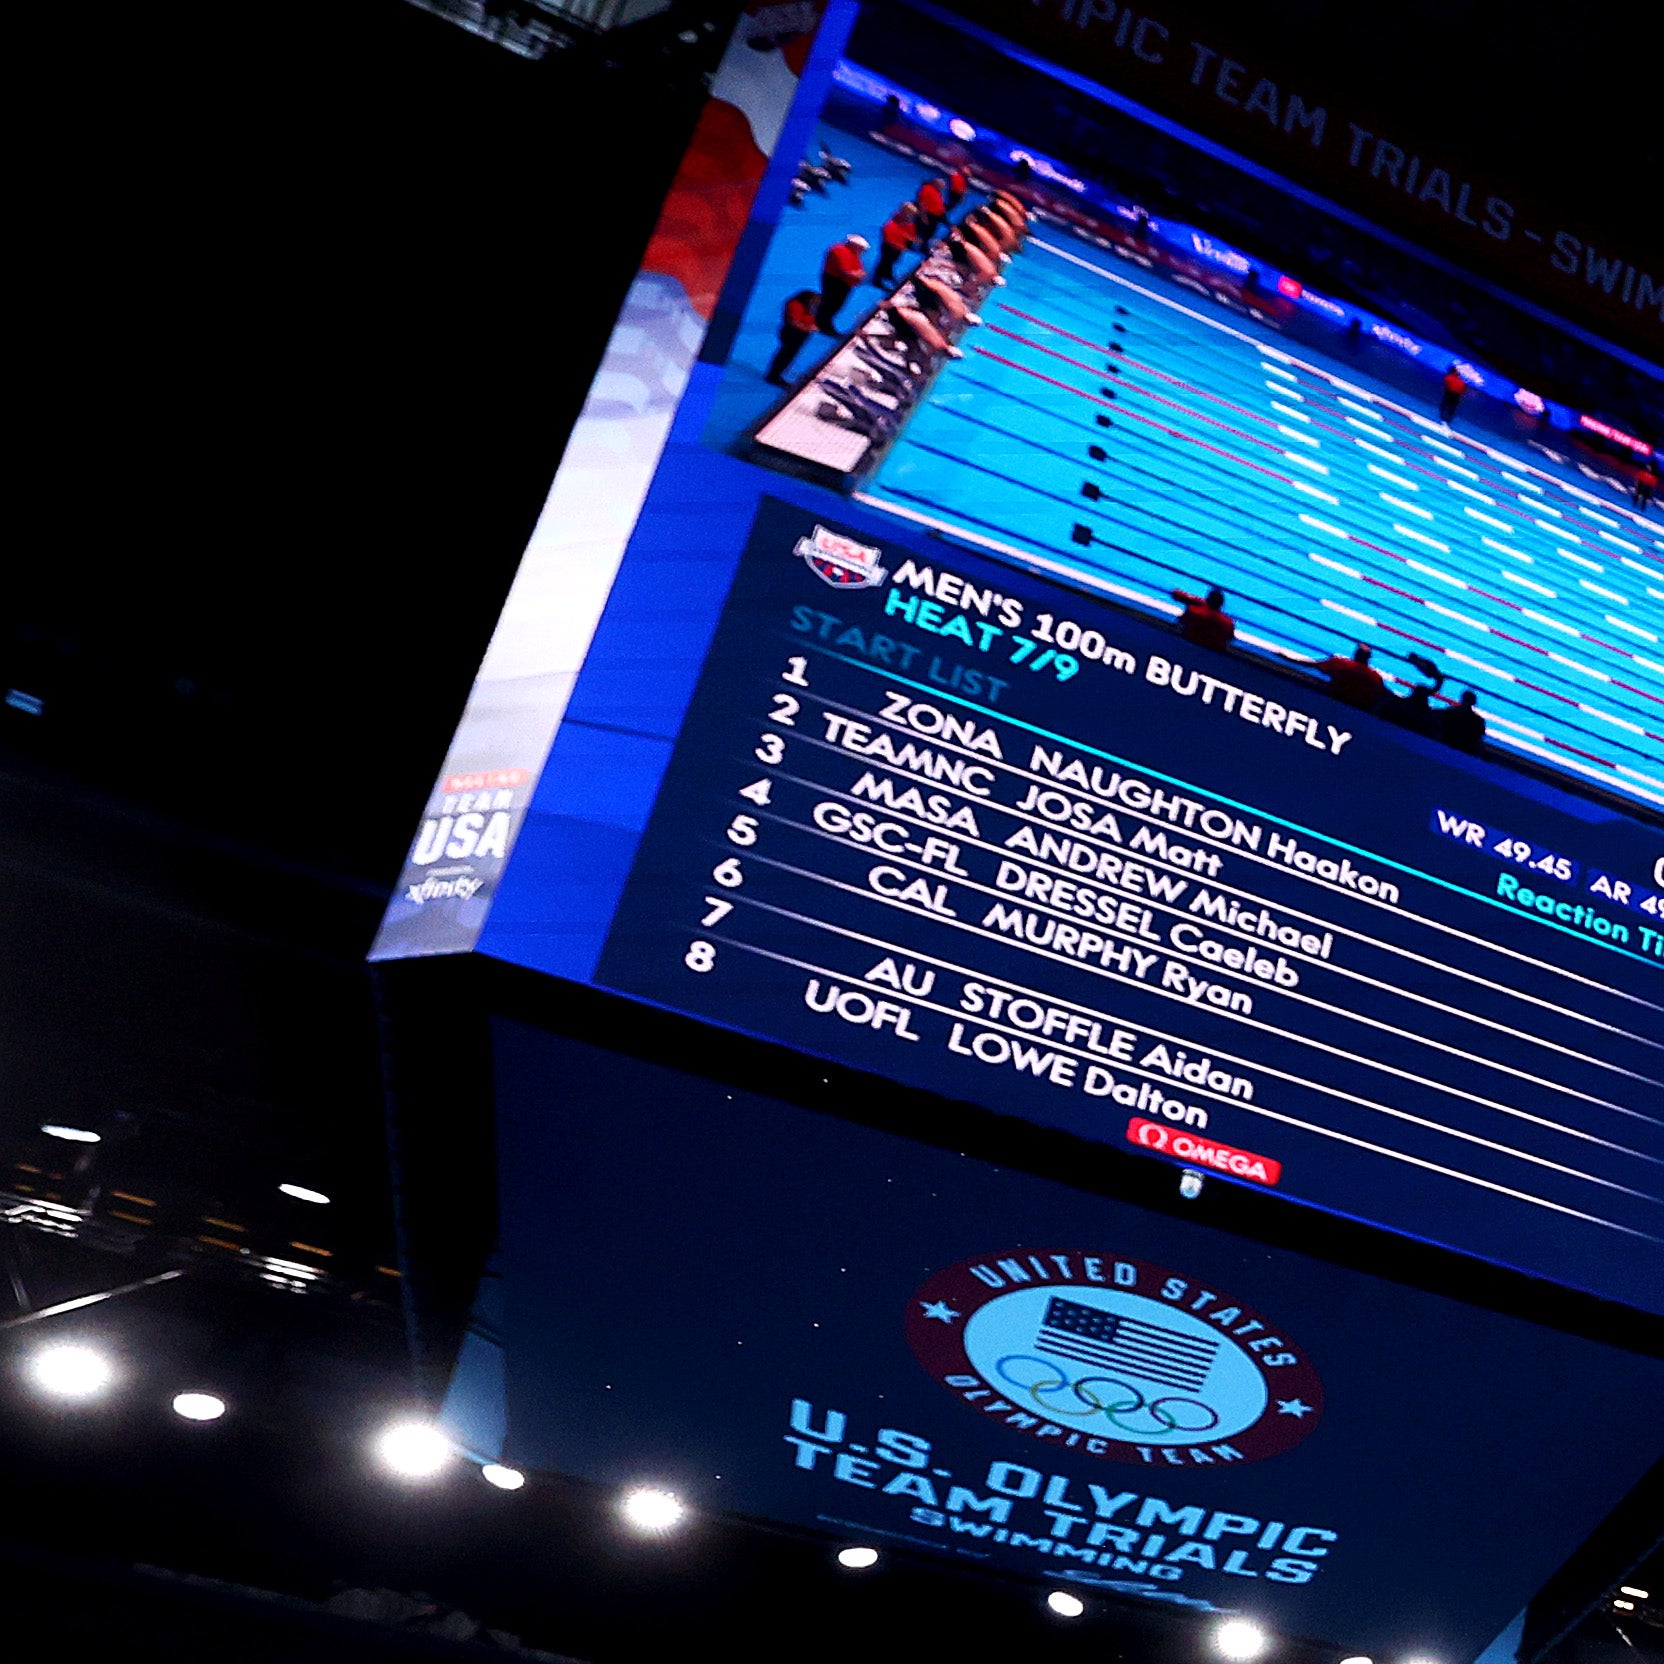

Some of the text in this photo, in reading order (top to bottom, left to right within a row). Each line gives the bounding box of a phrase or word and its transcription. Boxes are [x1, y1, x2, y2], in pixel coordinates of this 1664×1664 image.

[1189, 41, 1330, 149] TEAM
[789, 605, 1010, 704] START LIST
[884, 587, 1080, 684] HEAT 7/9
[891, 559, 1352, 756] MEN'S 100m BUTTERFLY
[768, 694, 1224, 879] 2 TEAMNC JOSA Matt
[781, 655, 1401, 904] 1 ZONA NAUGHTON Haakon
[411, 811, 512, 866] USA
[712, 856, 744, 889] 6
[739, 777, 1301, 988] 4 GSC-FL DRESSEL Caeleb
[754, 732, 1334, 959] 3 MASA ANDREW Michael
[1436, 809, 1487, 848] WR
[1492, 835, 1574, 882] 49.45
[1590, 874, 1632, 907] AR
[726, 814, 1254, 1015] 5 CAL MURPHY Ryan
[1495, 873, 1630, 944] Reaction
[685, 939, 1210, 1129] 8 UOFL LOWE Dalton
[700, 896, 1255, 1102] 7 AU STOFFLE Aidan
[1172, 1136, 1269, 1181] OMEGA
[970, 1254, 1299, 1371] UNITED STATES
[789, 1398, 953, 1479] U.S.
[986, 1460, 1340, 1558] OLYMPIC
[944, 1373, 1246, 1468] OLYMPIC TEAM
[783, 1434, 1018, 1524] TEAM
[1044, 1508, 1319, 1587] TRIALS
[910, 1505, 1187, 1583] SWIMMING
